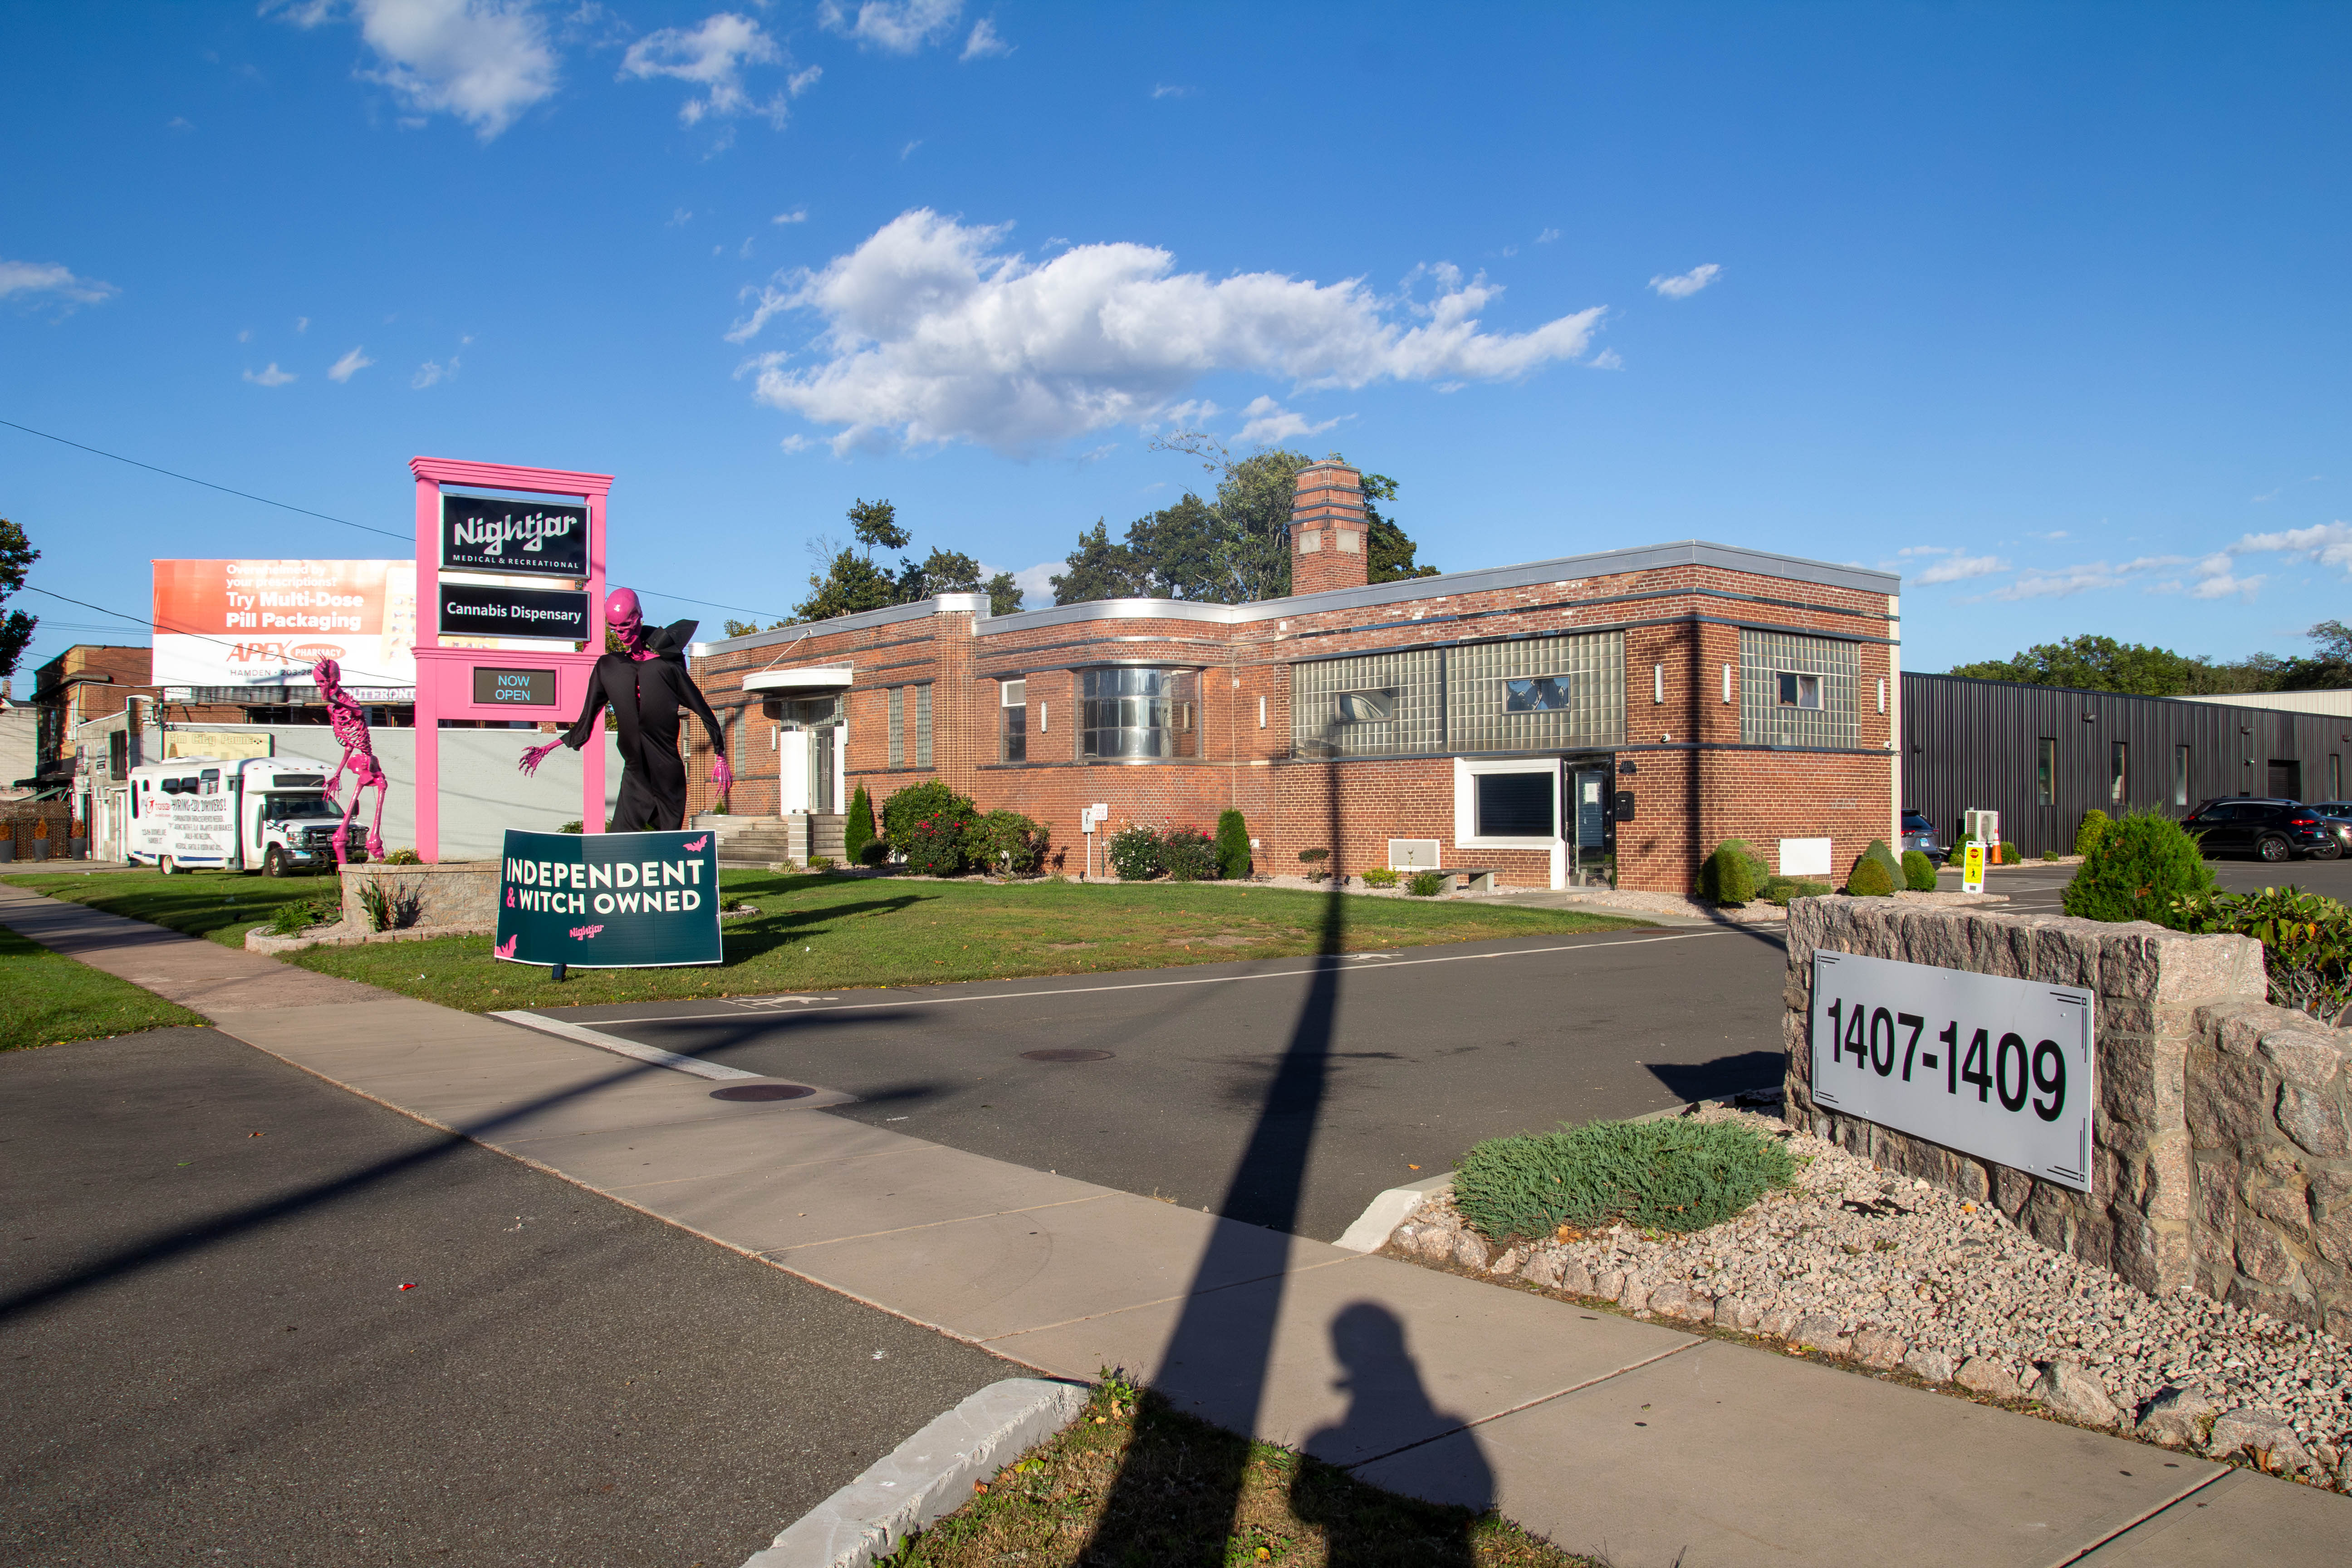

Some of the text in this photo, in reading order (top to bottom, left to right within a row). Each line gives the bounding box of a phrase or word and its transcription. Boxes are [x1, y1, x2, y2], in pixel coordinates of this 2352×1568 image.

[455, 512, 577, 555] Nightjar
[226, 564, 326, 576] Overwhelmed by
[453, 554, 496, 564] MEDICAL
[508, 559, 579, 568] RECREATIONAL
[226, 577, 337, 588] your prescriptions?
[226, 591, 364, 610] Try Multi-Dose
[226, 611, 362, 631] Pill Packaging
[447, 602, 582, 624] Cannabis Dispensary
[226, 639, 342, 665] APEX PHARMACY
[498, 675, 530, 686] NOW
[495, 690, 530, 701] OPEN
[168, 734, 186, 743] Elm
[192, 734, 216, 746] City
[201, 798, 227, 812] DRIVERS!
[506, 857, 704, 888] INDEPENDENT
[506, 887, 701, 914] & WITCH OWNED
[569, 924, 604, 941] Nightjar
[1828, 997, 2066, 1122] 1407-1409
